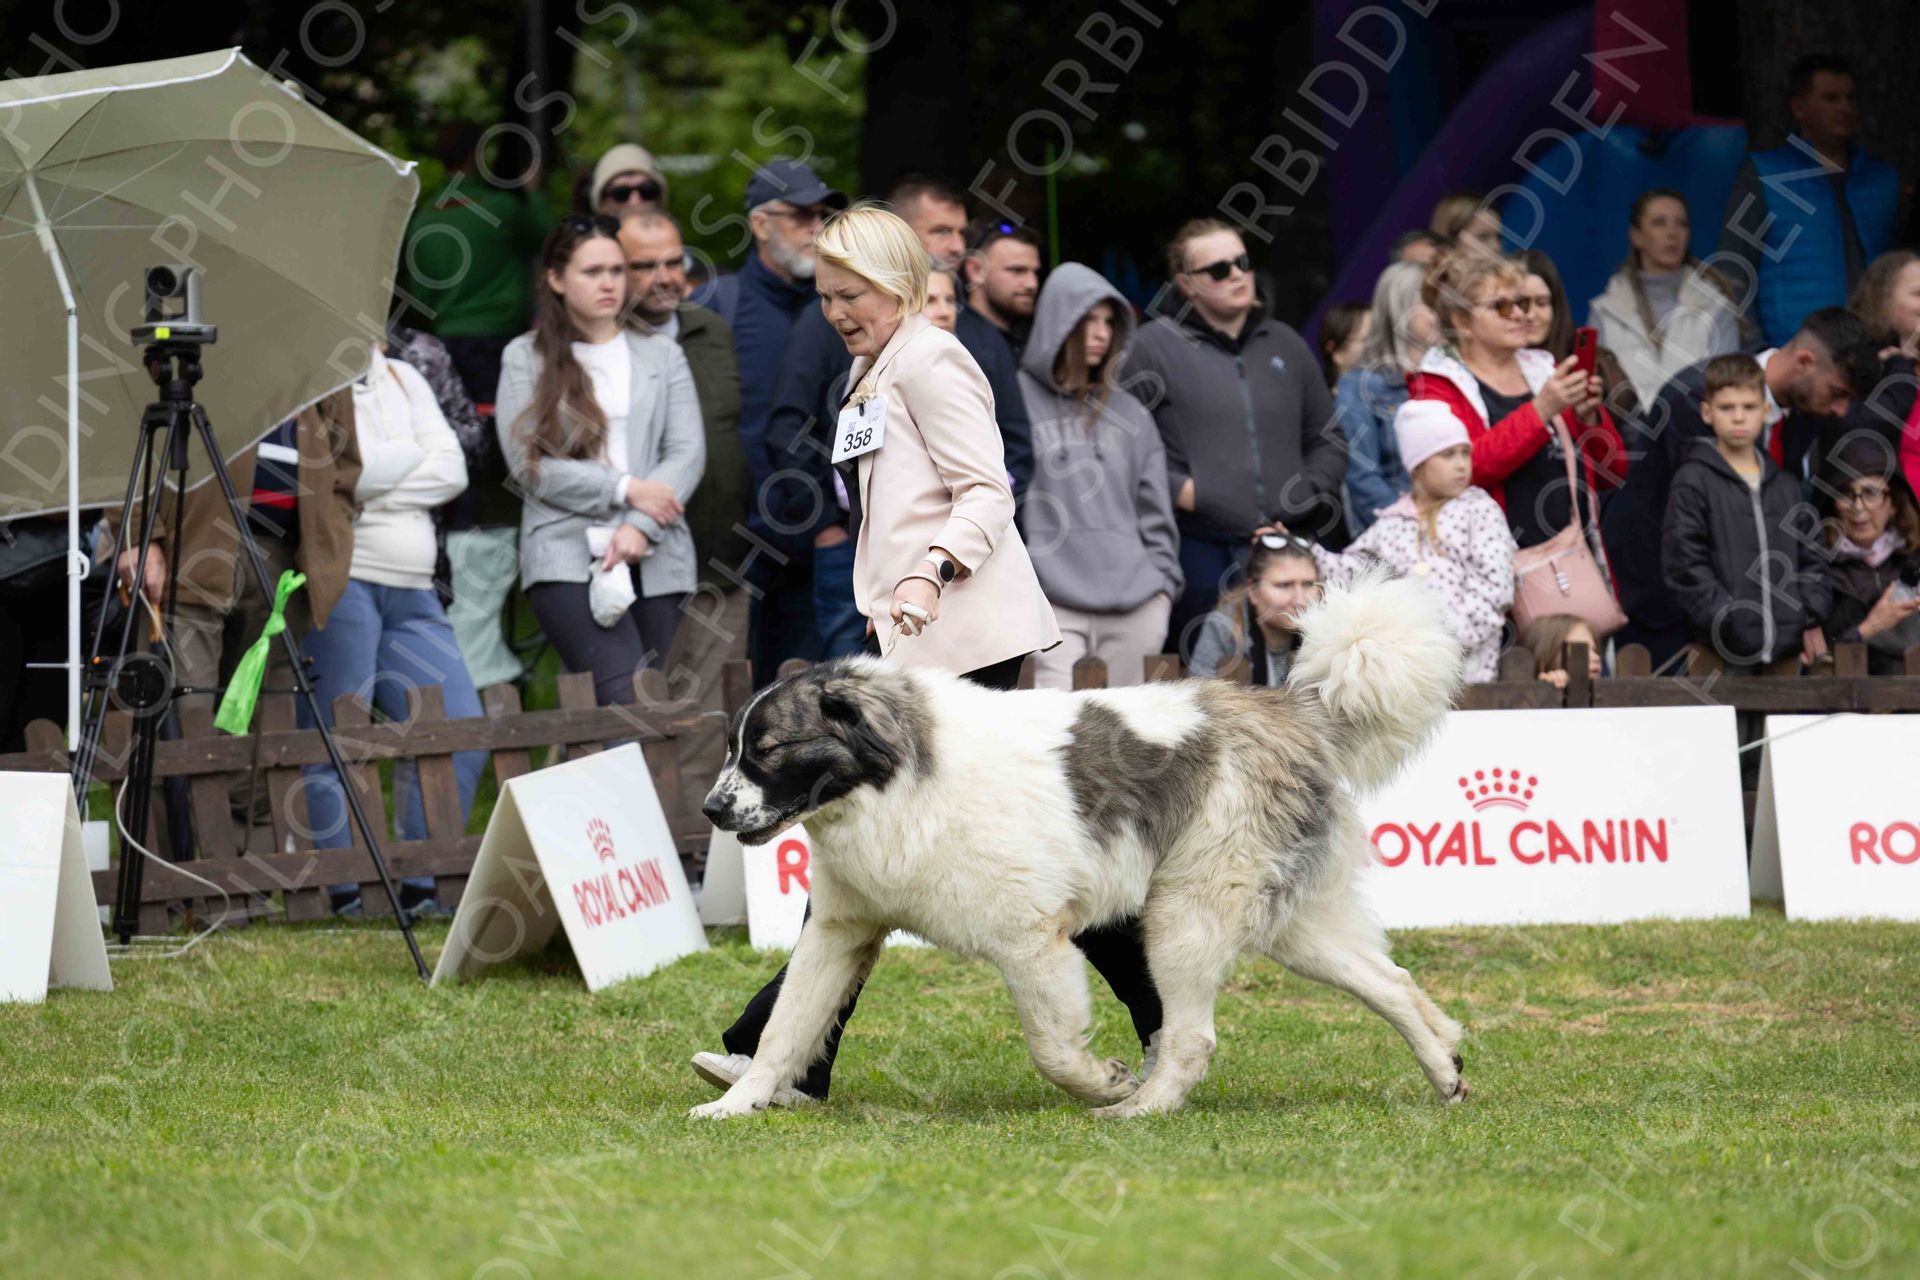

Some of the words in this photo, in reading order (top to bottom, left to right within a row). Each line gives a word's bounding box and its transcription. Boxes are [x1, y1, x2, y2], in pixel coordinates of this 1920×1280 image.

[843, 427, 873, 453] 358
[1368, 820, 1497, 868] OYAL
[1508, 817, 1669, 865] CANIN
[572, 873, 627, 929] ROYAL
